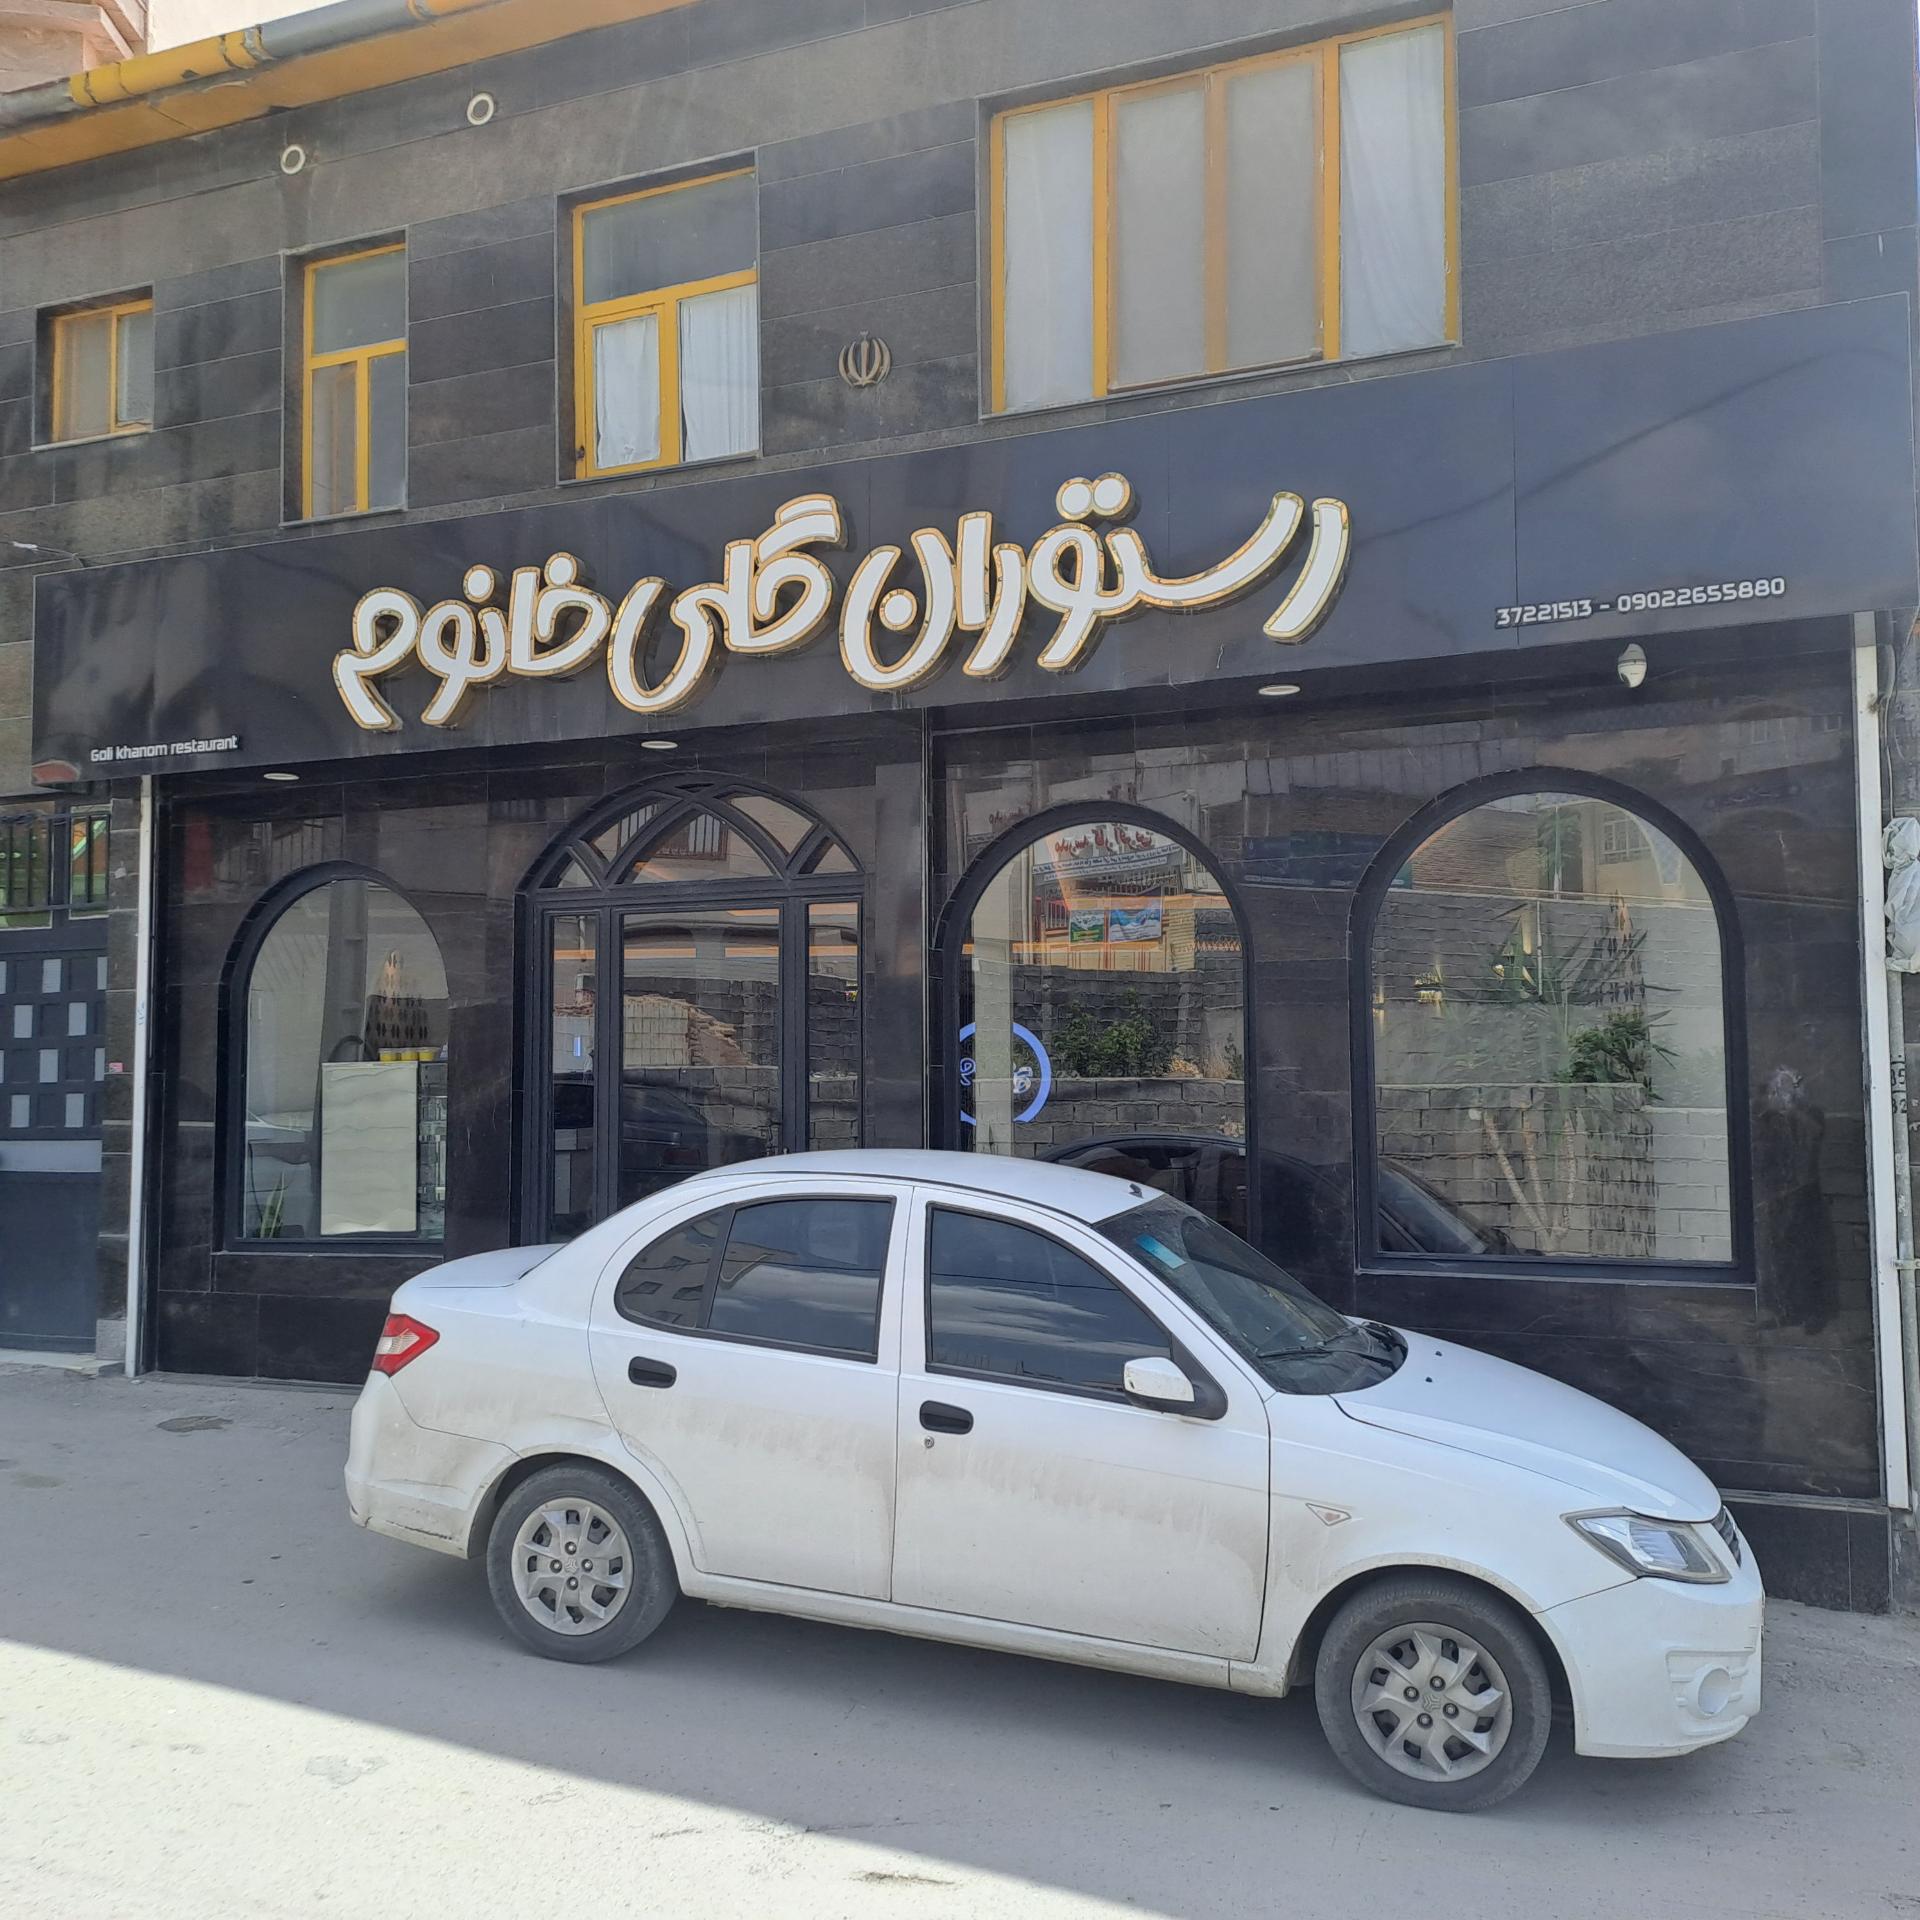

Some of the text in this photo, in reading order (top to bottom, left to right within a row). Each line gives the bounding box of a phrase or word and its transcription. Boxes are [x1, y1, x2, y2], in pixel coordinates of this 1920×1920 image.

[332, 471, 1351, 731] رستوران گلی خانوم
[1496, 599, 1592, 626] 37221513
[1617, 577, 1786, 612] 09022655880
[91, 747, 113, 762] Goli
[170, 735, 239, 755] restaurant
